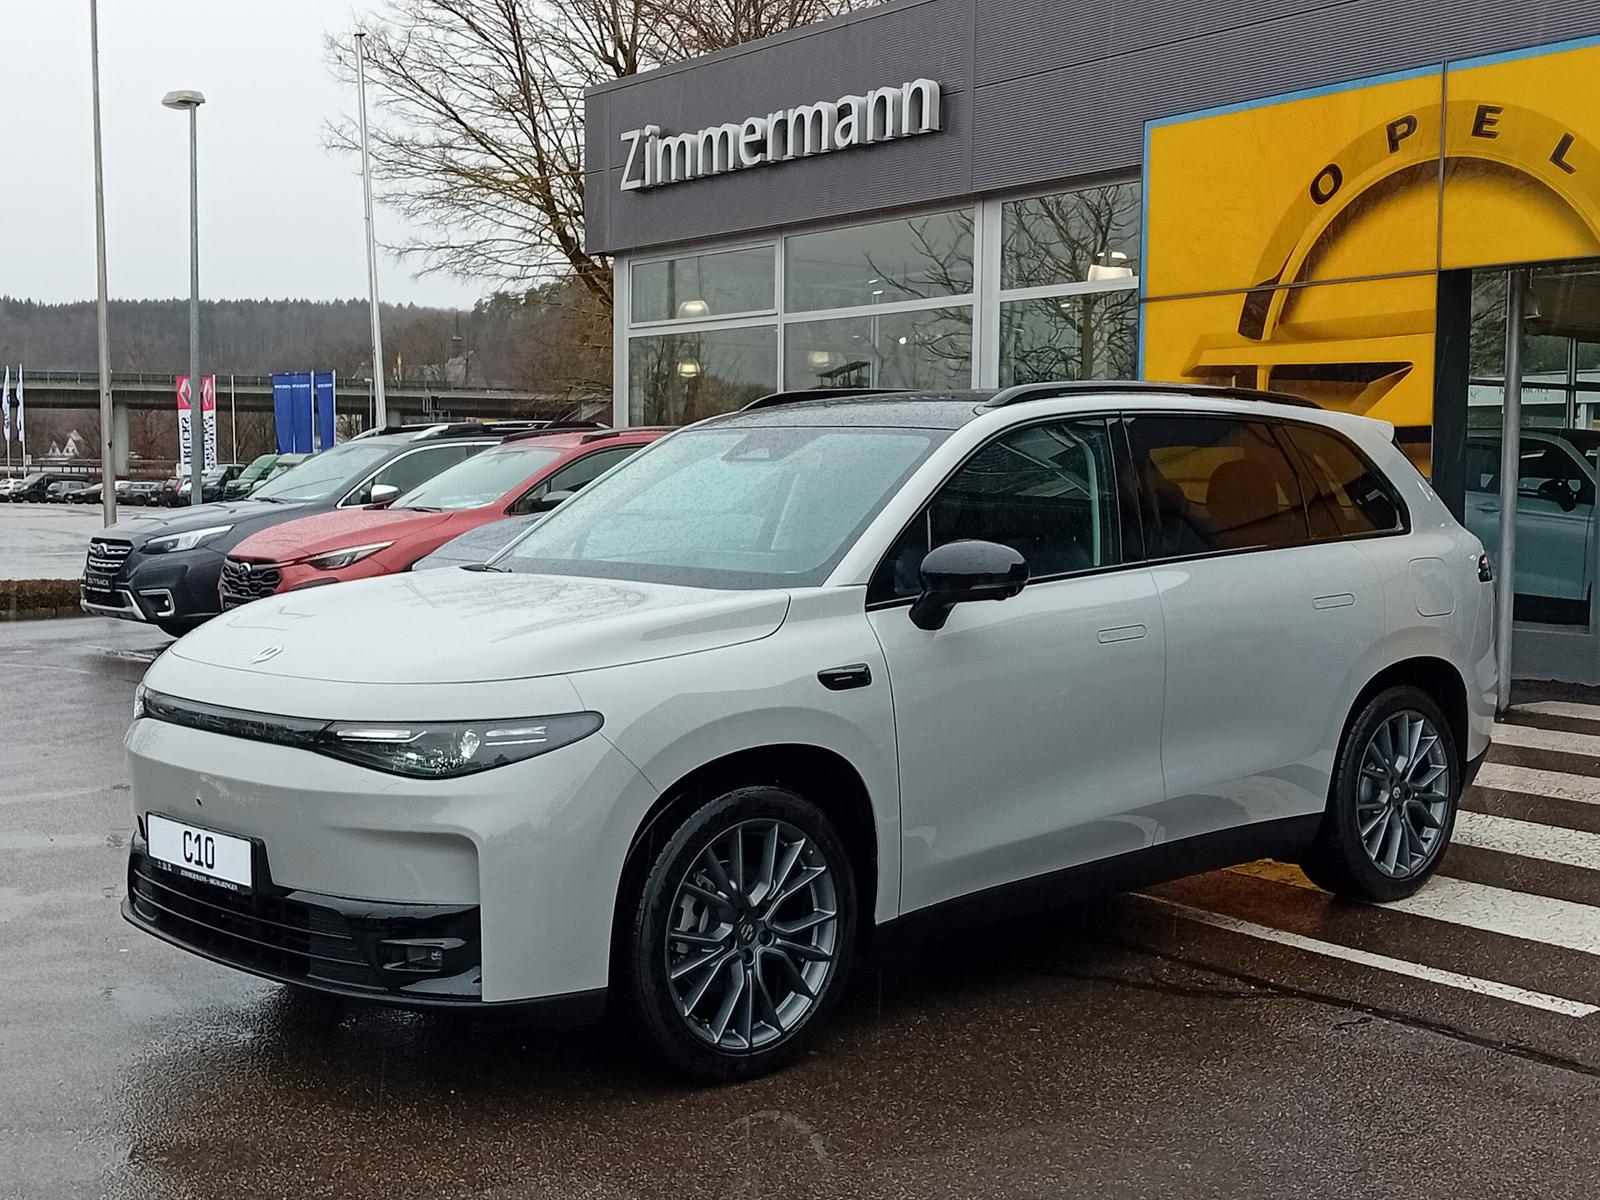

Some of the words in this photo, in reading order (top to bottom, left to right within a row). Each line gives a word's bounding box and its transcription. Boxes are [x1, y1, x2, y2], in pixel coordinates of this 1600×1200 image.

[619, 77, 943, 191] Zimmermann
[1309, 104, 1577, 205] OPEL
[183, 830, 215, 870] C10
